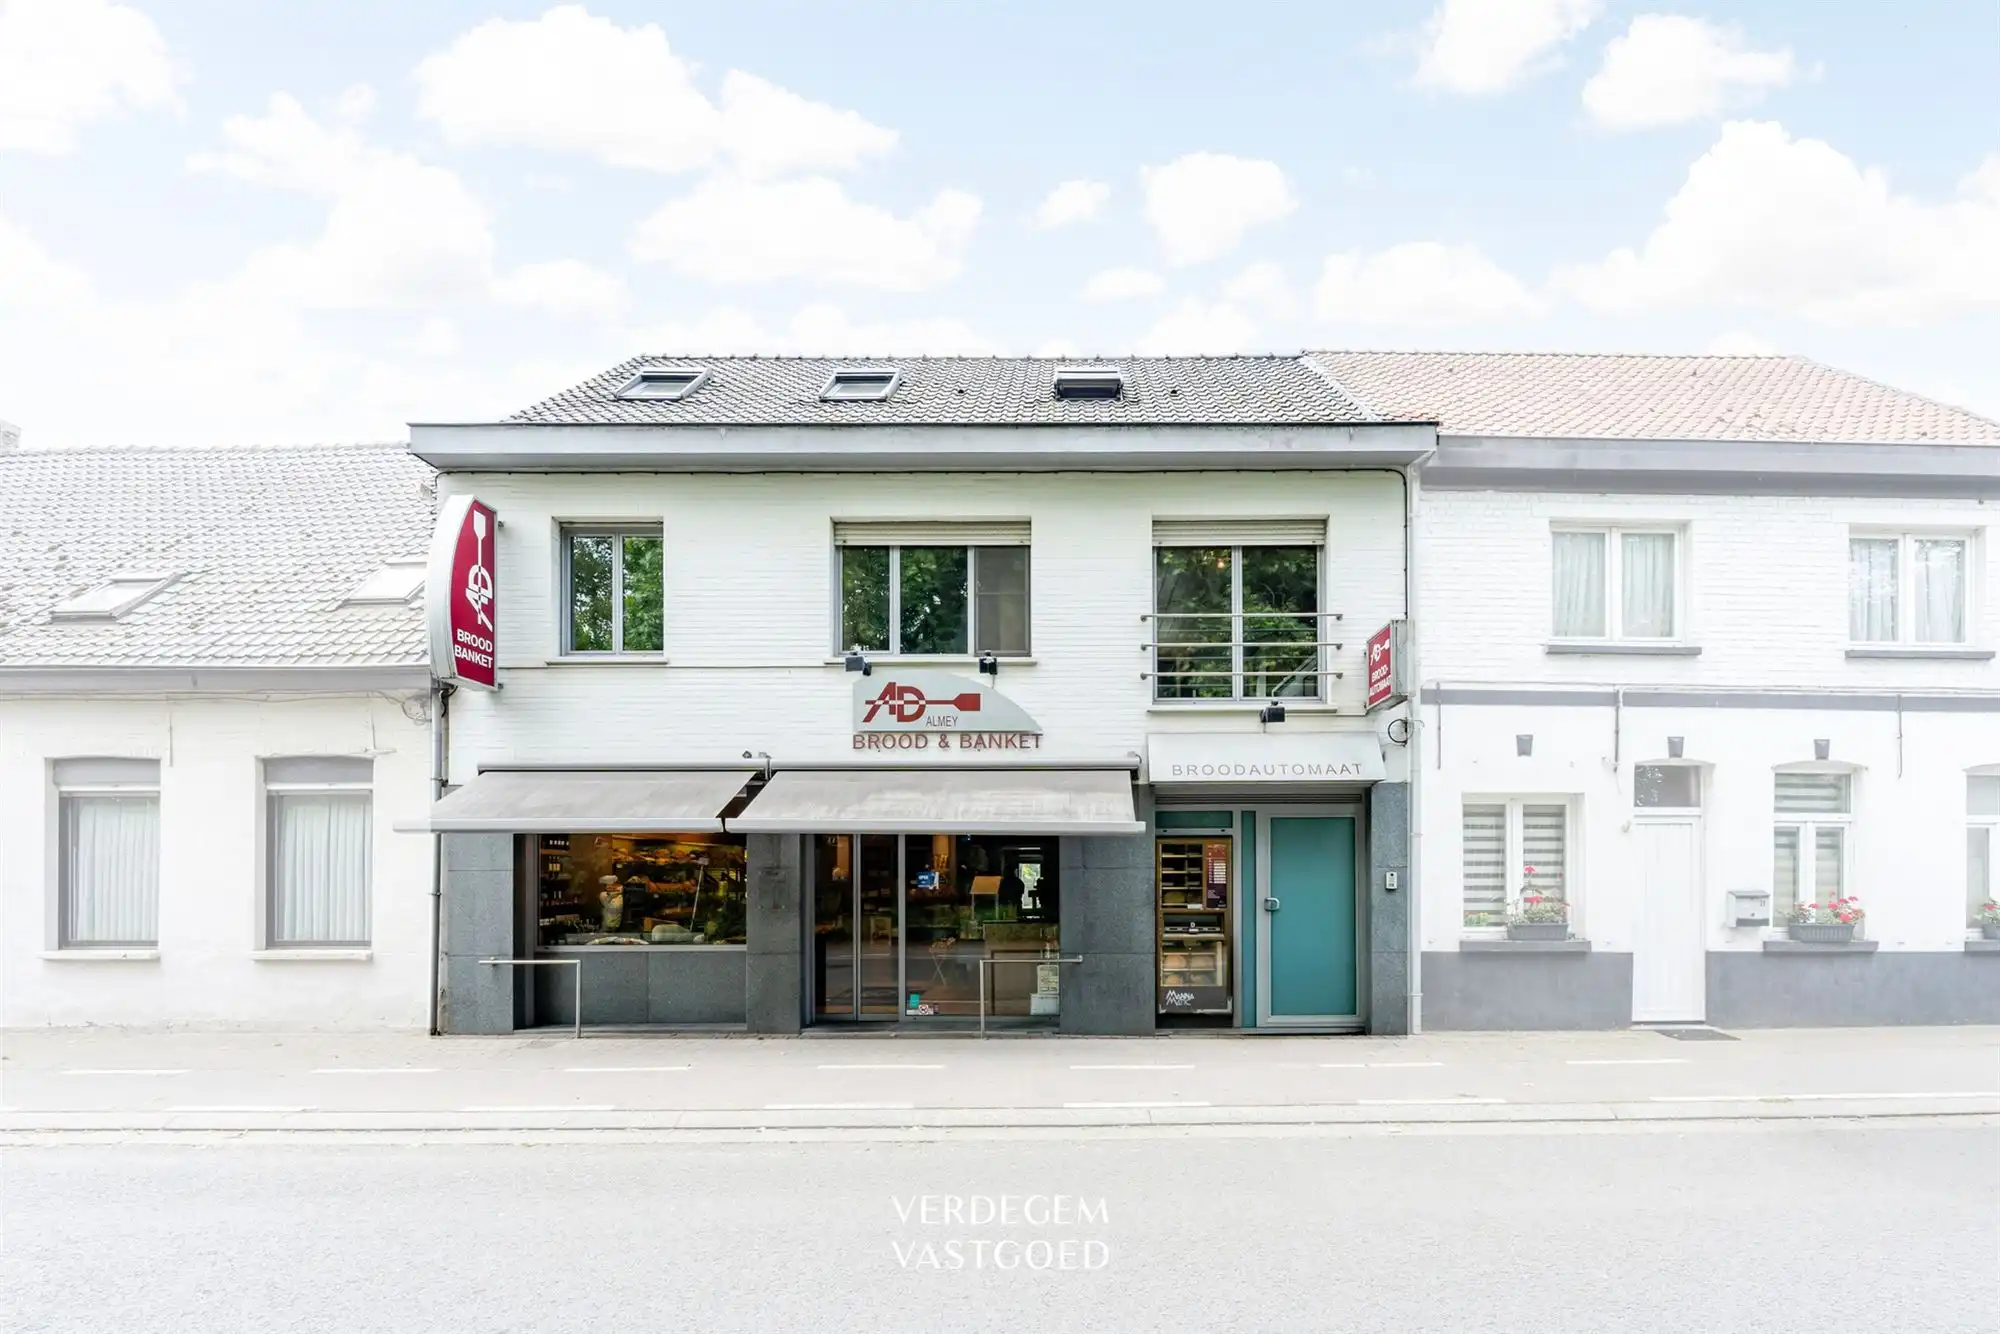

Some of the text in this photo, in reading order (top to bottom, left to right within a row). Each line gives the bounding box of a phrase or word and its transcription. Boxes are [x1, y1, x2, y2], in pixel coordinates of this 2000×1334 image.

[456, 628, 493, 653] BROOD
[454, 644, 493, 669] BANKET
[925, 715, 958, 728] ALMEY
[852, 733, 1044, 750] BROOD & BANKET
[1172, 762, 1362, 776] BROODAUTOMAAT
